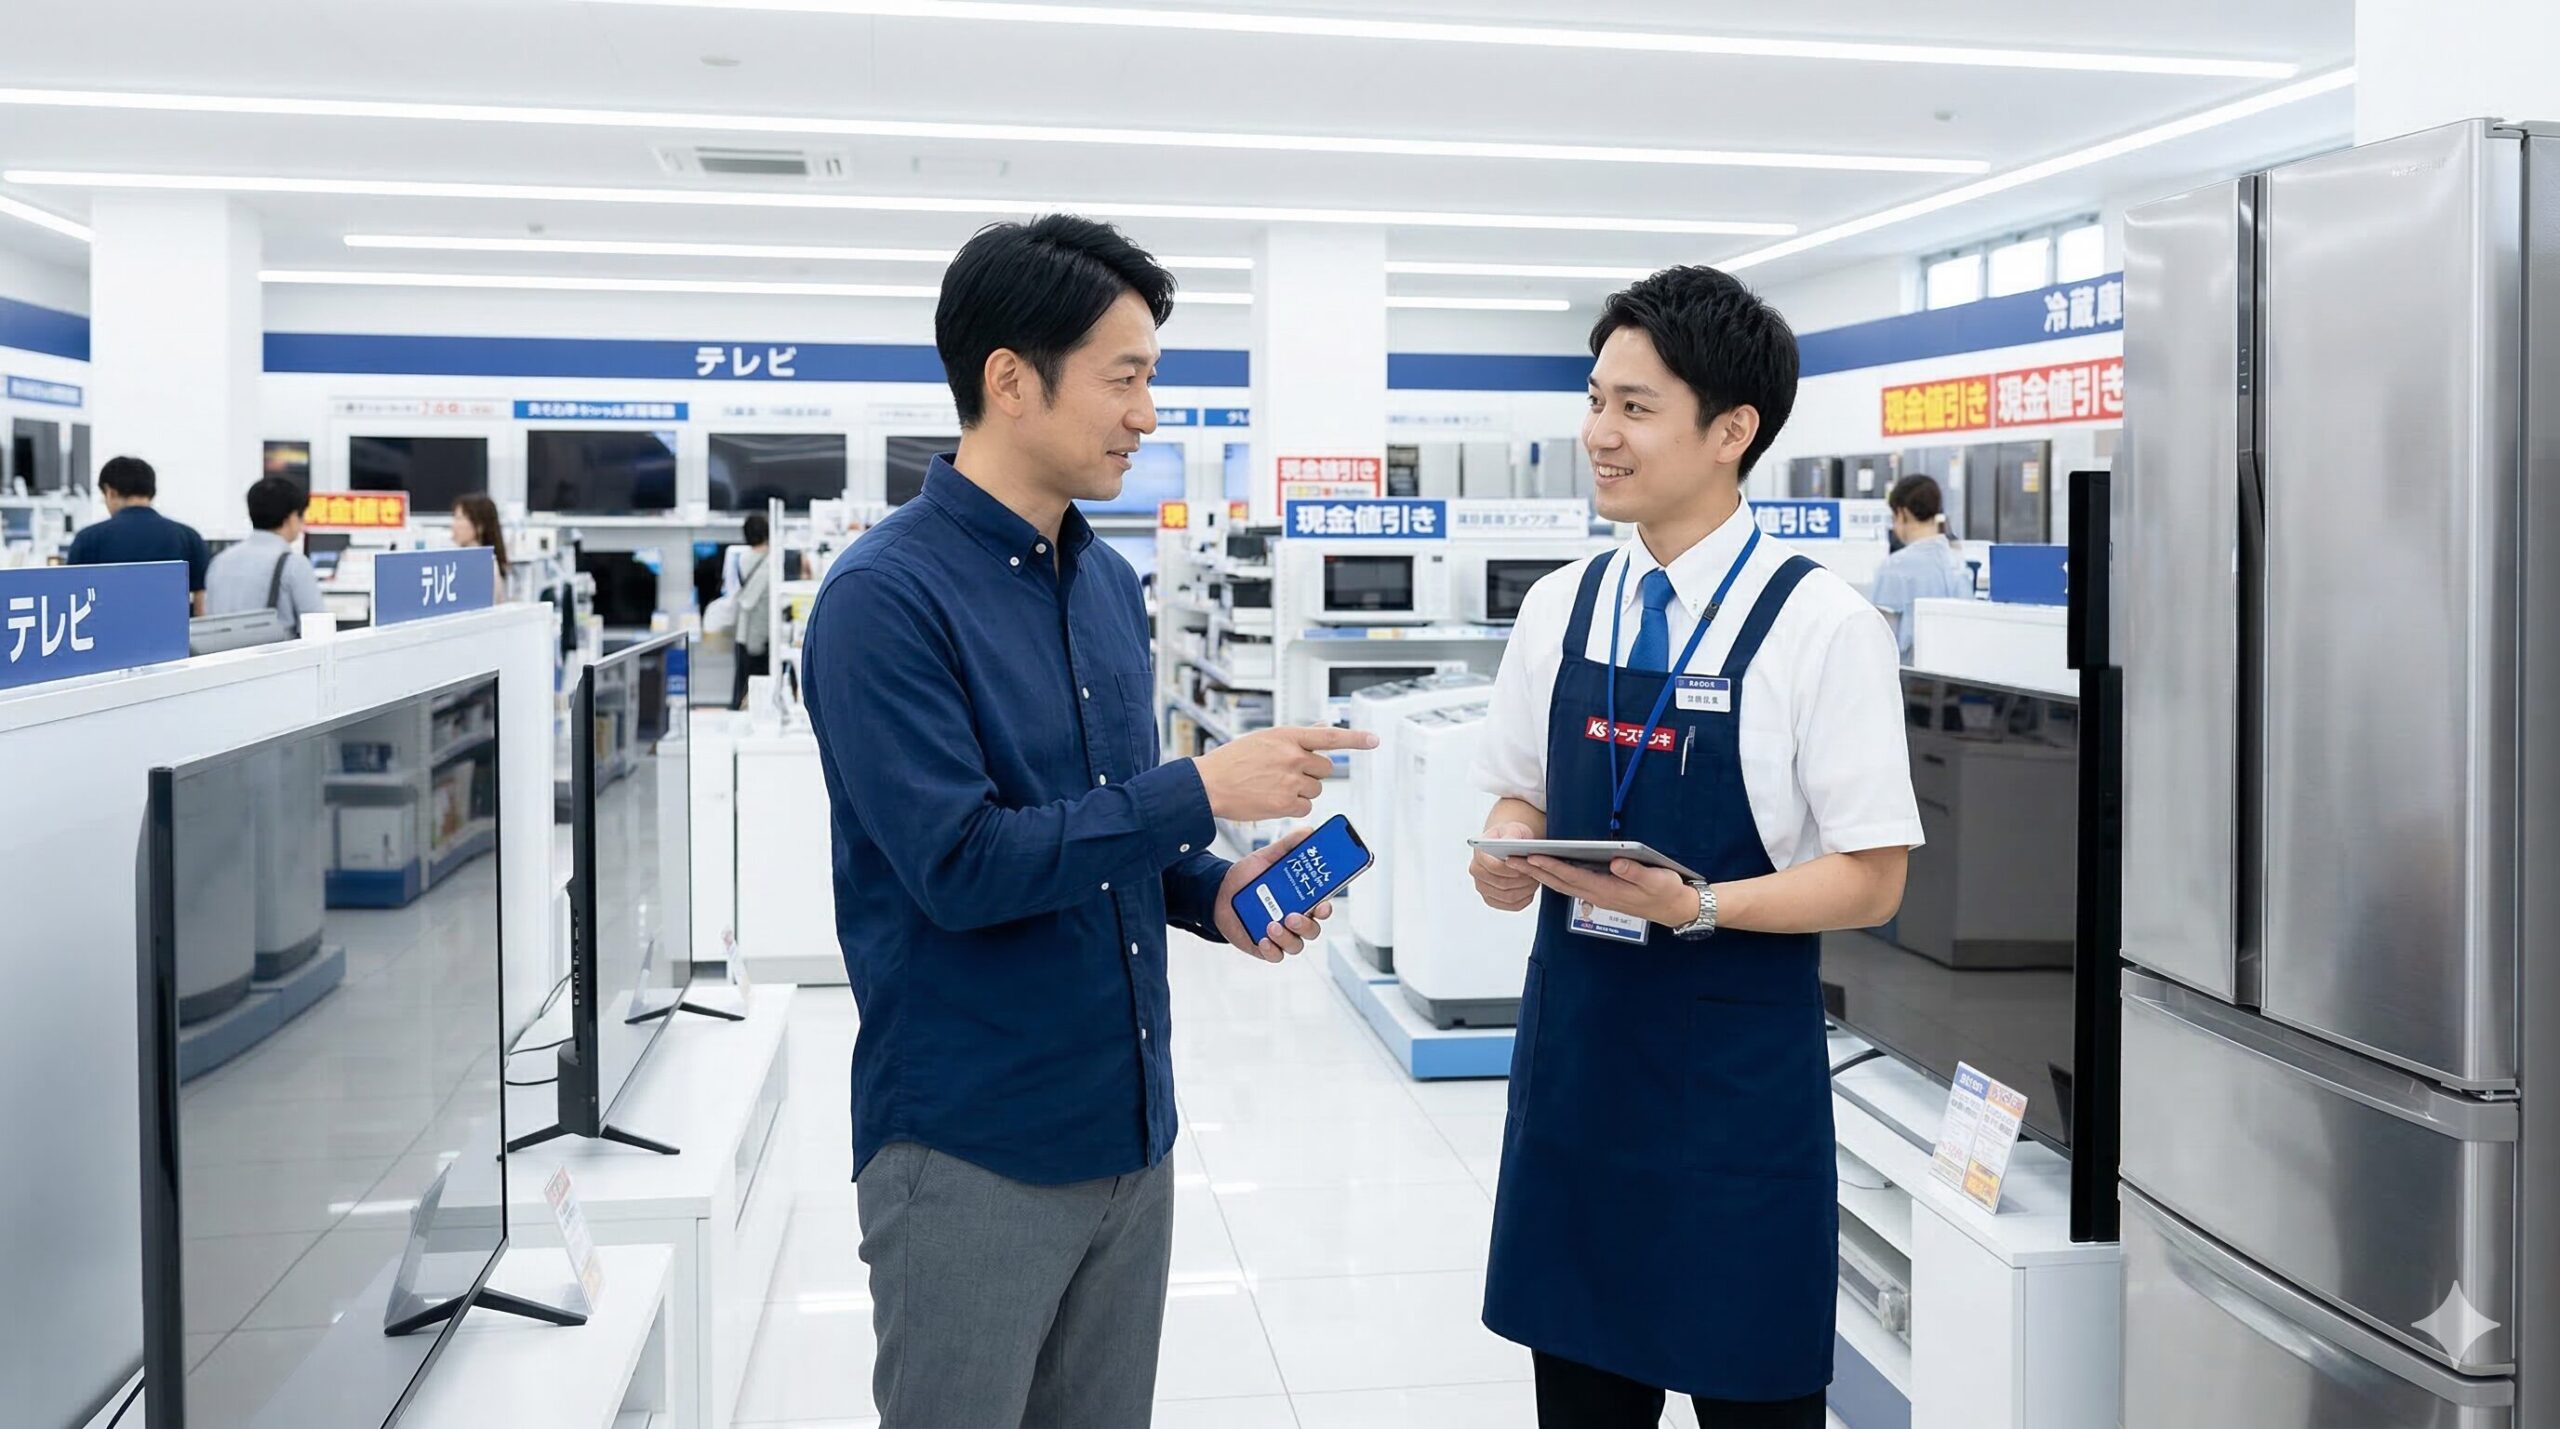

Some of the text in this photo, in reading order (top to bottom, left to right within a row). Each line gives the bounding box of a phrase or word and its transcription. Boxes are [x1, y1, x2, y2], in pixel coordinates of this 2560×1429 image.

[2043, 281, 2122, 332] 冷蔵庫
[695, 346, 797, 377] テレビ
[1885, 381, 1988, 433] 現金値引き
[1998, 365, 2122, 423] 現金値引き
[1296, 504, 1436, 535] 現金値引き
[421, 561, 457, 607] テレビ
[8, 587, 96, 664] テレビ
